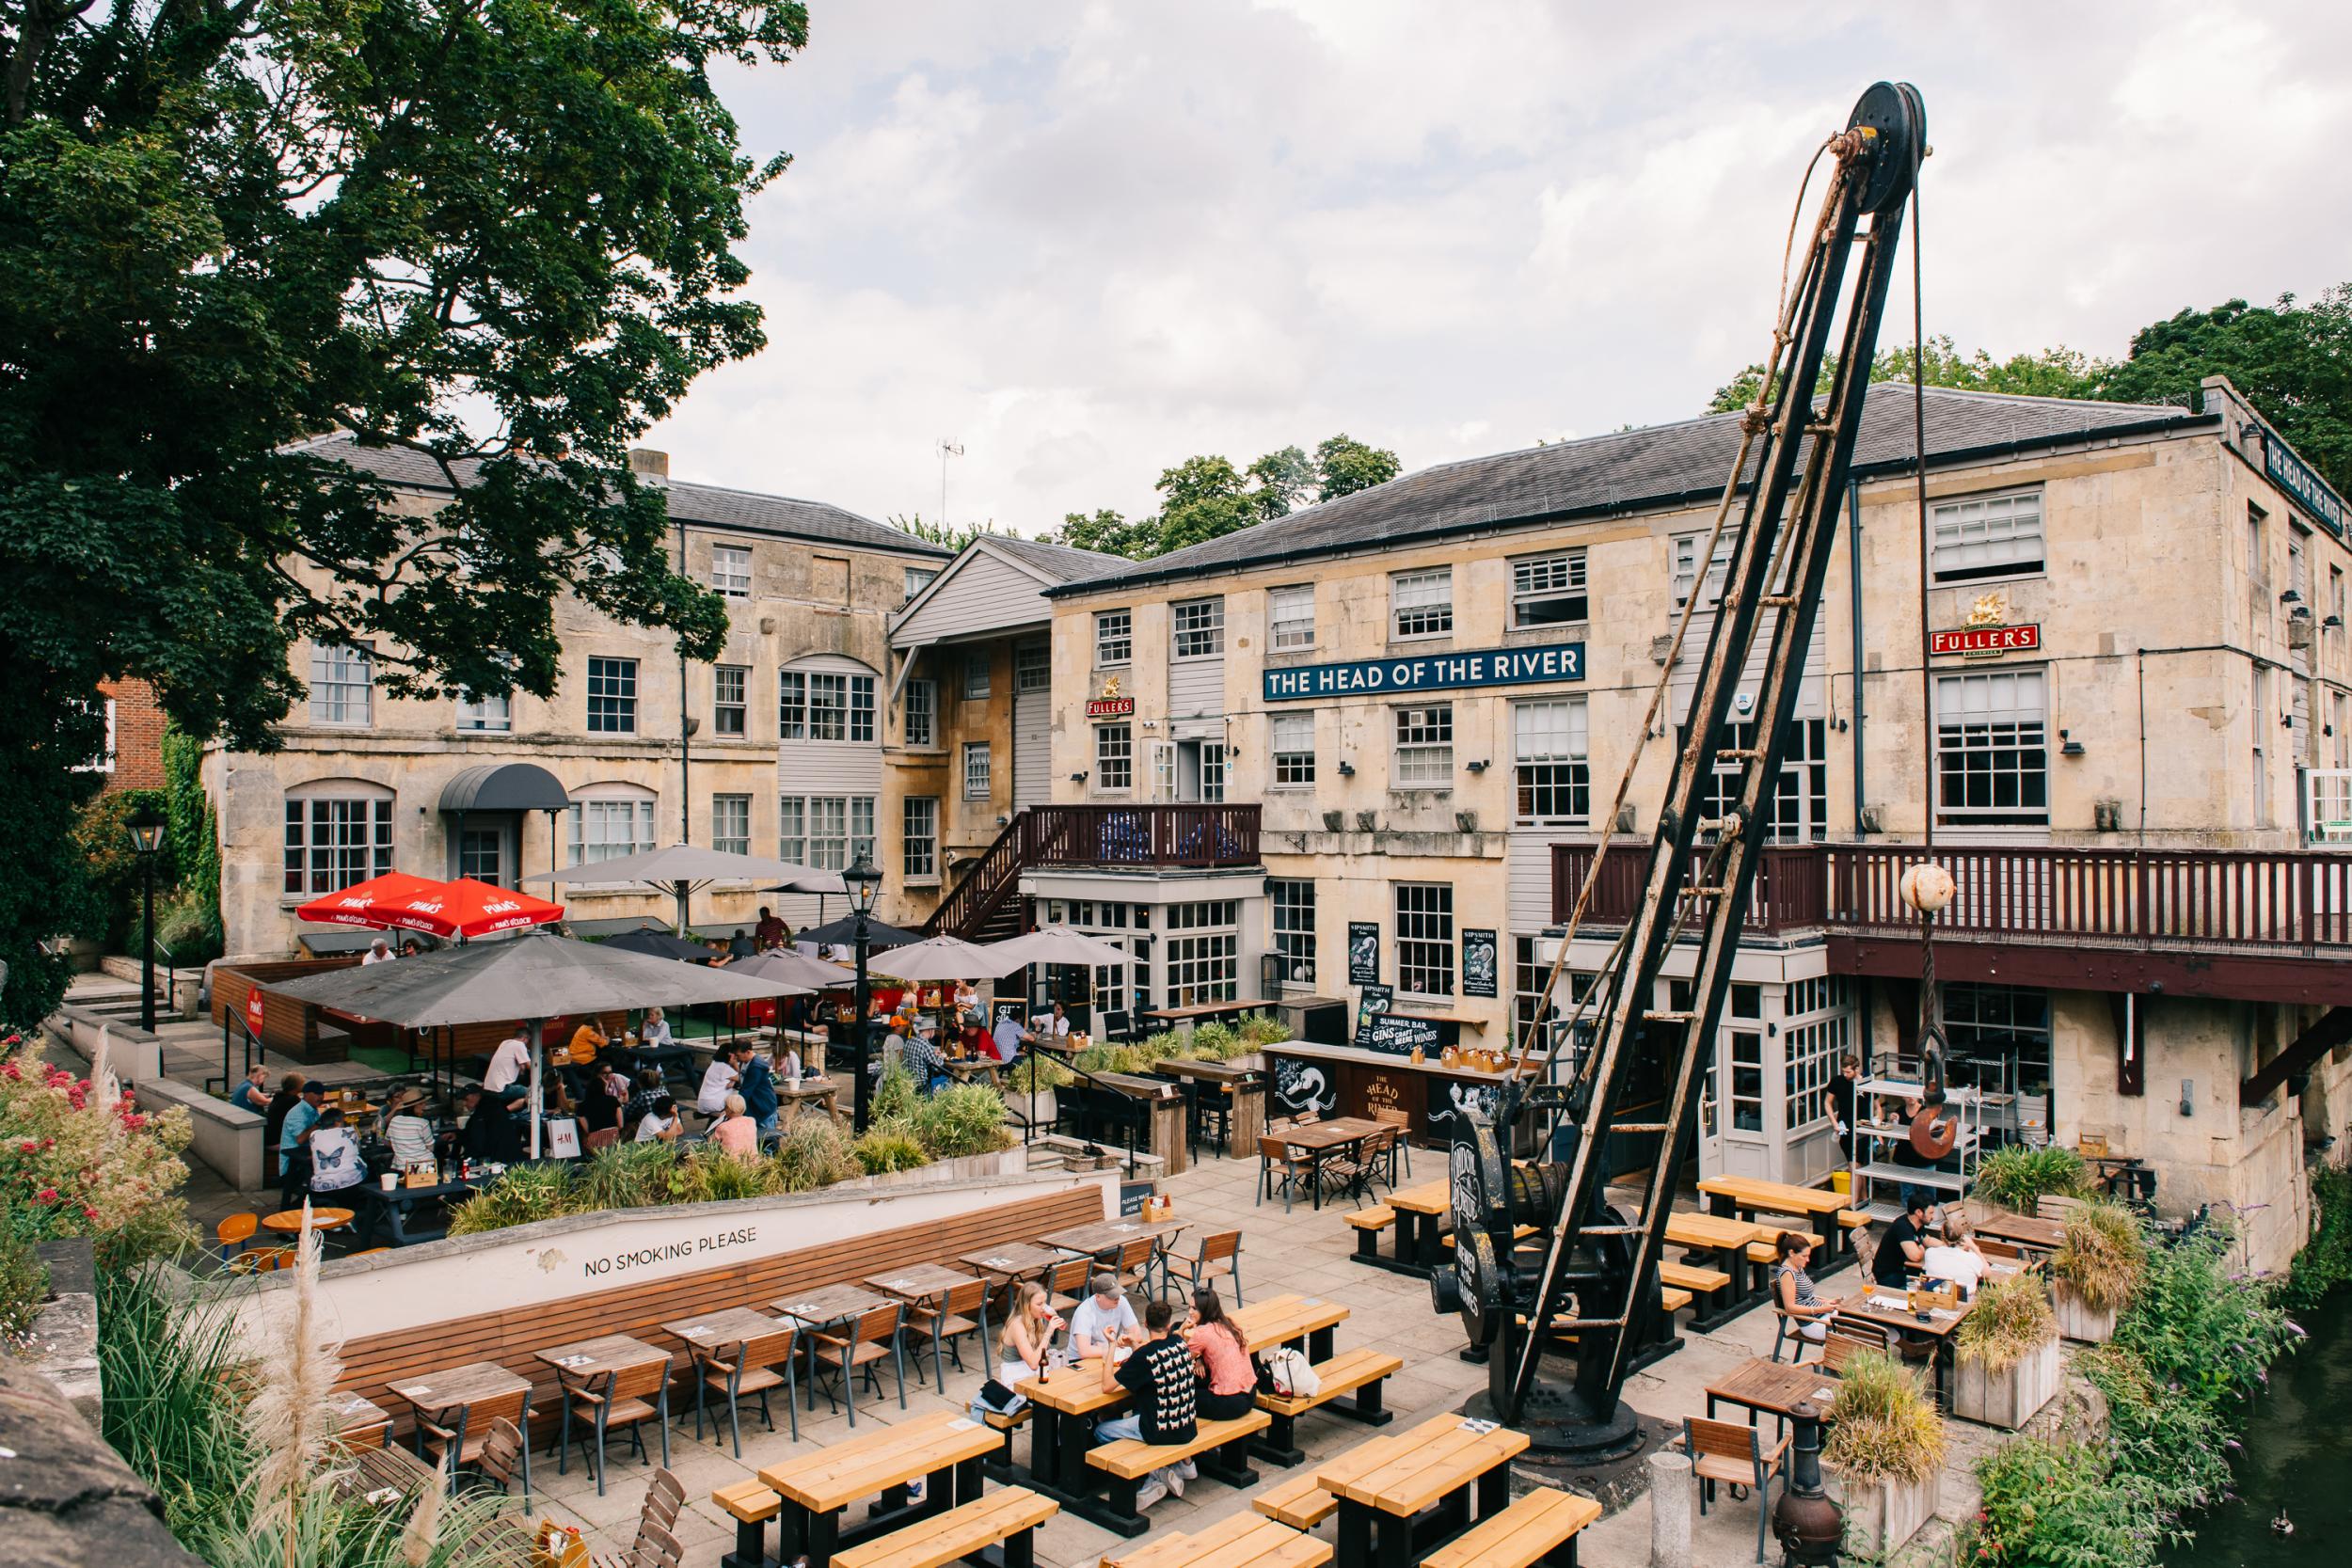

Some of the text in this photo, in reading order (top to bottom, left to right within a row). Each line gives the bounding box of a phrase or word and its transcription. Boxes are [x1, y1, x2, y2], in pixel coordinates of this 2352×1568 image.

[2267, 440, 2341, 528] THE HEAD OF THE RIVER
[1935, 628, 2030, 650] FULLER'S
[1269, 650, 1578, 694] THE HEAD OF THE RIVER
[1089, 701, 1129, 713] FULLER'S
[406, 901, 444, 914] PIMM'S
[482, 900, 521, 914] PIMM'S
[1380, 1018, 1427, 1030] SUMMER BAR
[1372, 1027, 1394, 1041] GINS
[1394, 1029, 1413, 1038] CRAFT
[1414, 1030, 1438, 1043] WINES
[1394, 1036, 1413, 1045] BEERS
[1366, 1083, 1399, 1100] HEAD
[1121, 1196, 1138, 1205] PLEASE
[1125, 1204, 1139, 1212] HERE
[584, 1227, 756, 1277] NO SMOKING PLEASE
